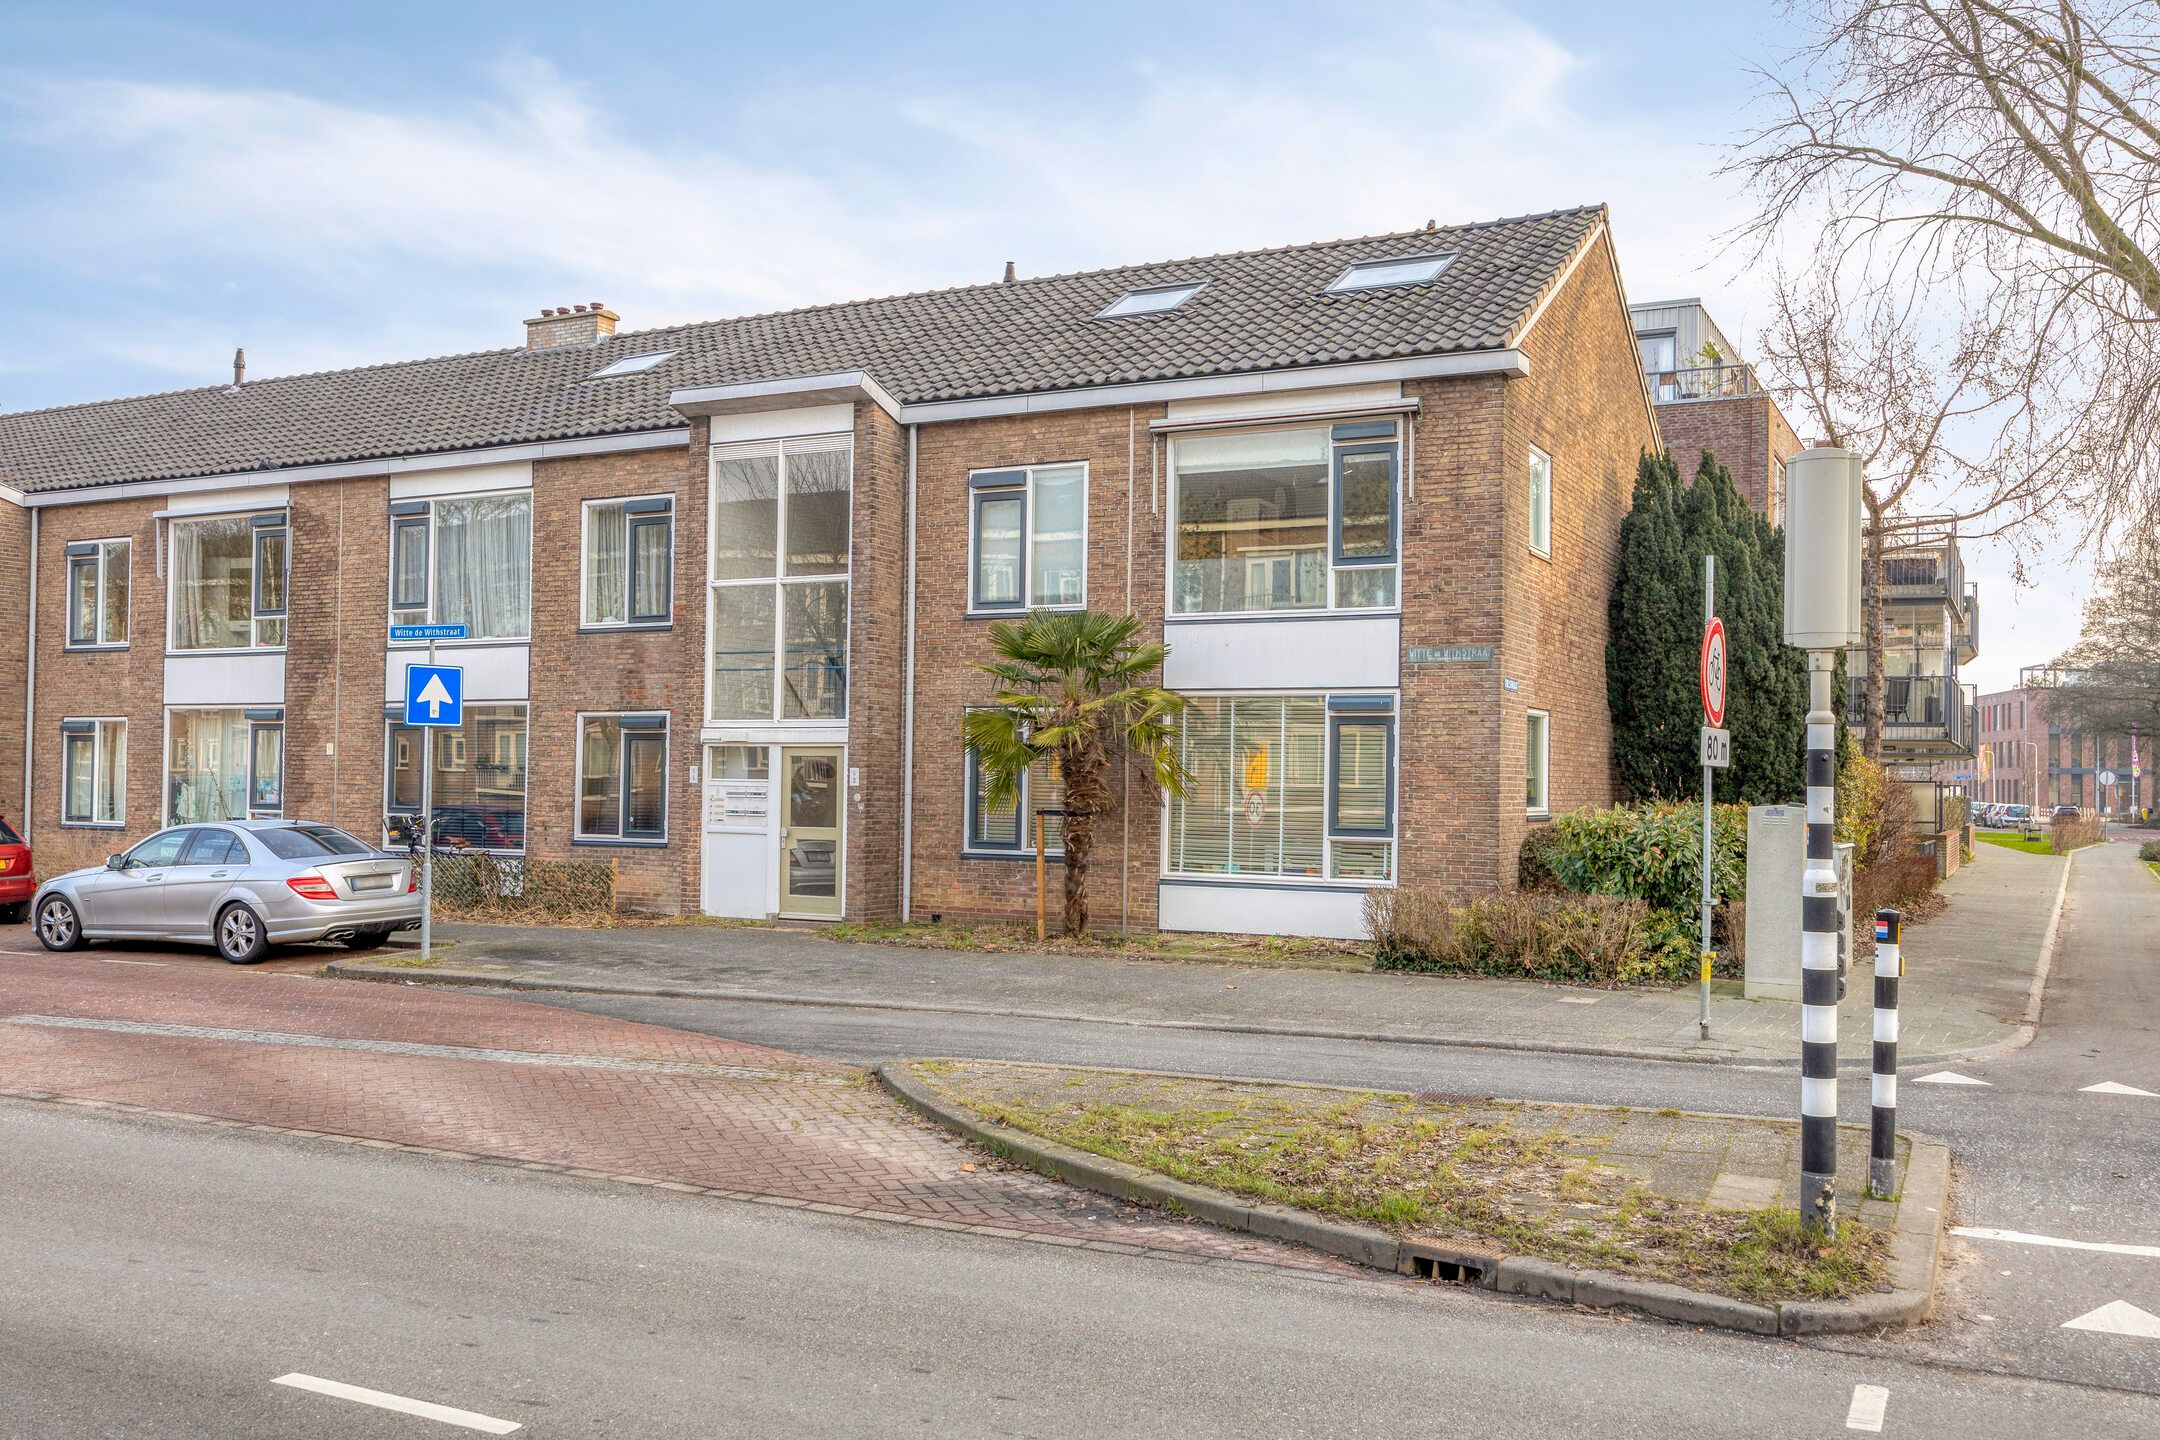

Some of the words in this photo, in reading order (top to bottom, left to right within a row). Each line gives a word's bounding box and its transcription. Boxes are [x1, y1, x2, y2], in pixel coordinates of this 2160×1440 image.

[424, 628, 460, 636] Withstraat
[1409, 648, 1431, 657] WITTE
[1706, 735, 1718, 761] 80
[1720, 741, 1728, 761] m
